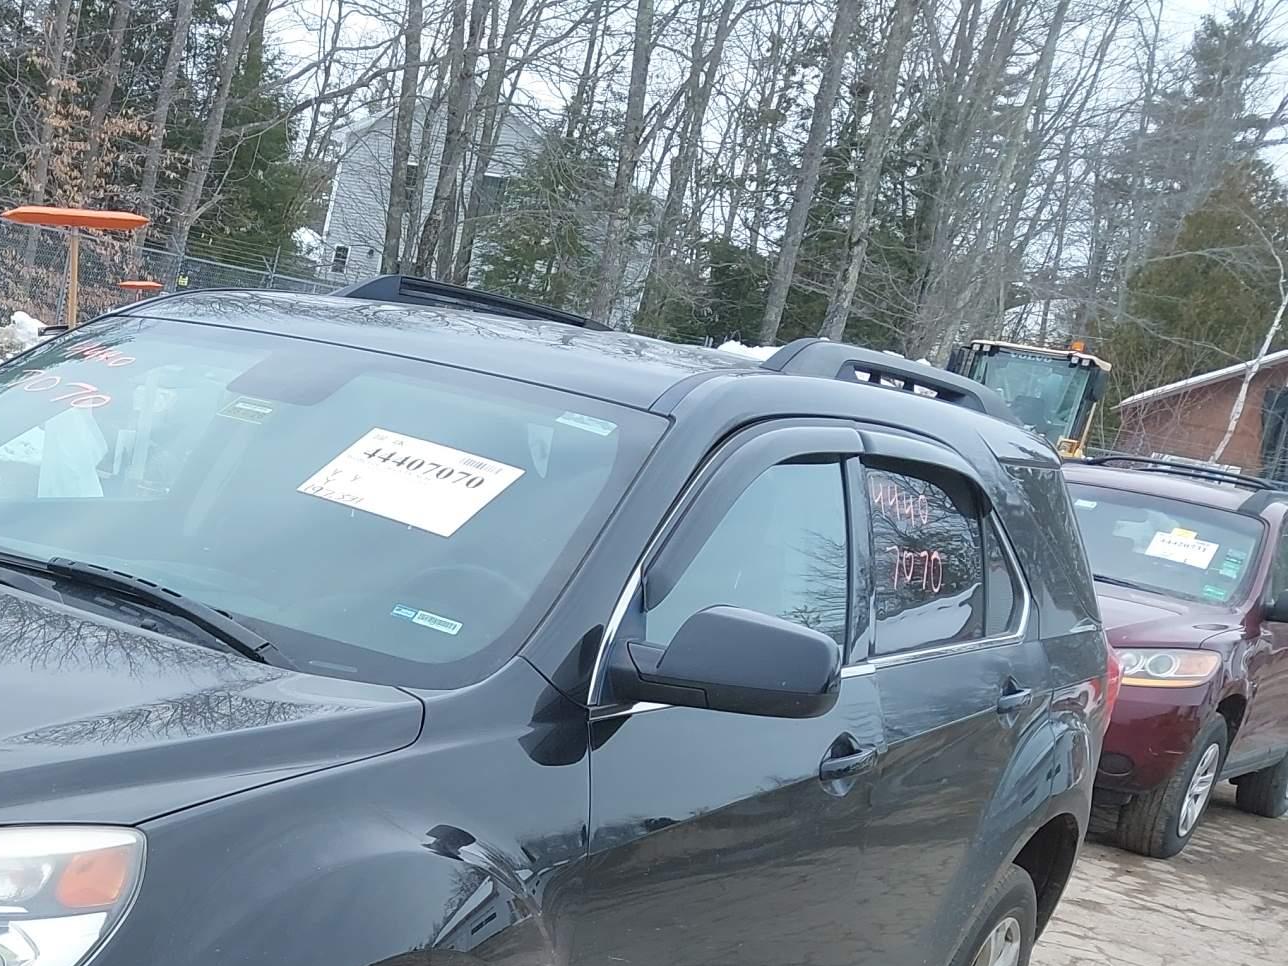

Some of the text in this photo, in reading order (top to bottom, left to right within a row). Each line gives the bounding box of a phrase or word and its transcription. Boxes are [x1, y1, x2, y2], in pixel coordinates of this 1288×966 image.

[363, 447, 485, 489] 44407070
[869, 476, 929, 529] 4440
[885, 545, 943, 593] 7070
